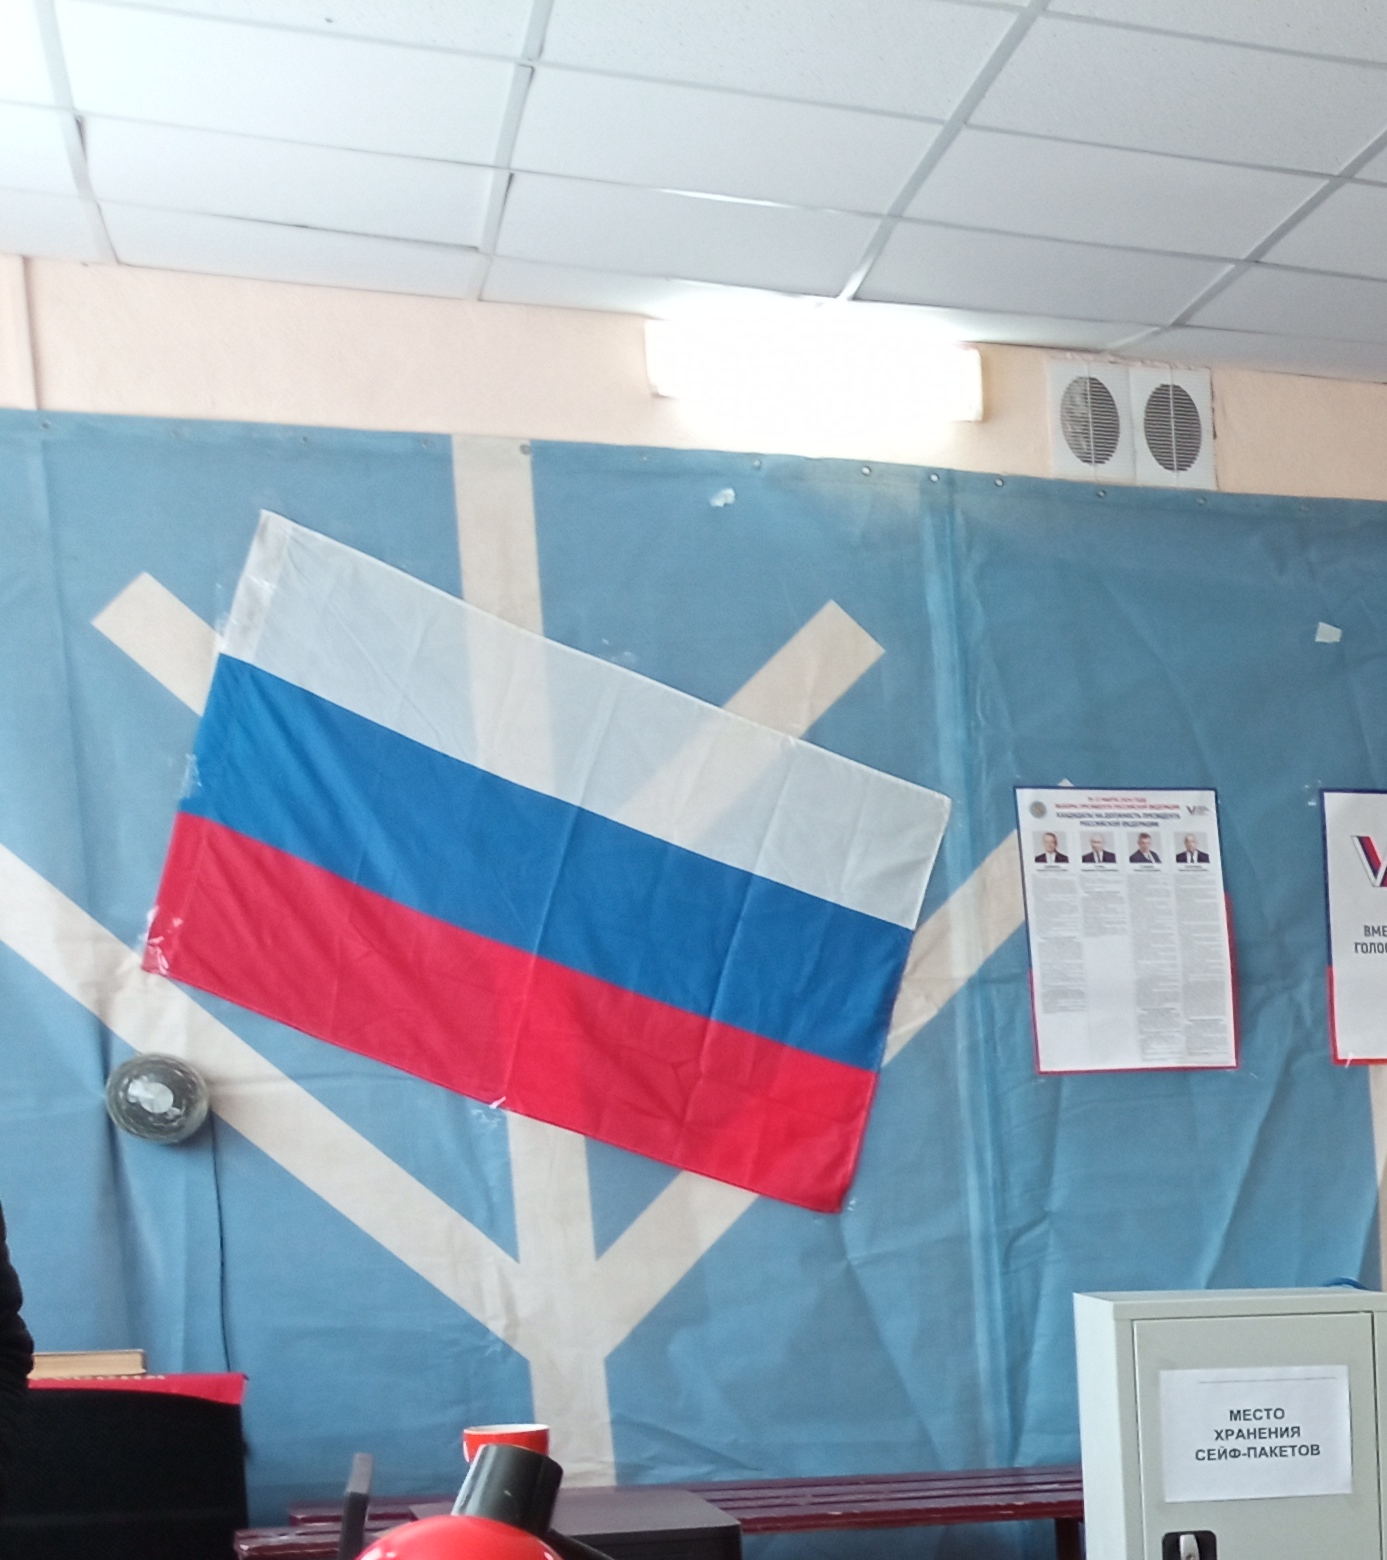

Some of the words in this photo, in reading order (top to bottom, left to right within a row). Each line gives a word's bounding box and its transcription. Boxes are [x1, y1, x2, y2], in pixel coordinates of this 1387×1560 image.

[1229, 1408, 1285, 1421] МЕСТО
[1214, 1426, 1301, 1441] ХРАНЕНИЯ
[1195, 1444, 1320, 1461] СЕЙФ-ПАКЕТОВ
